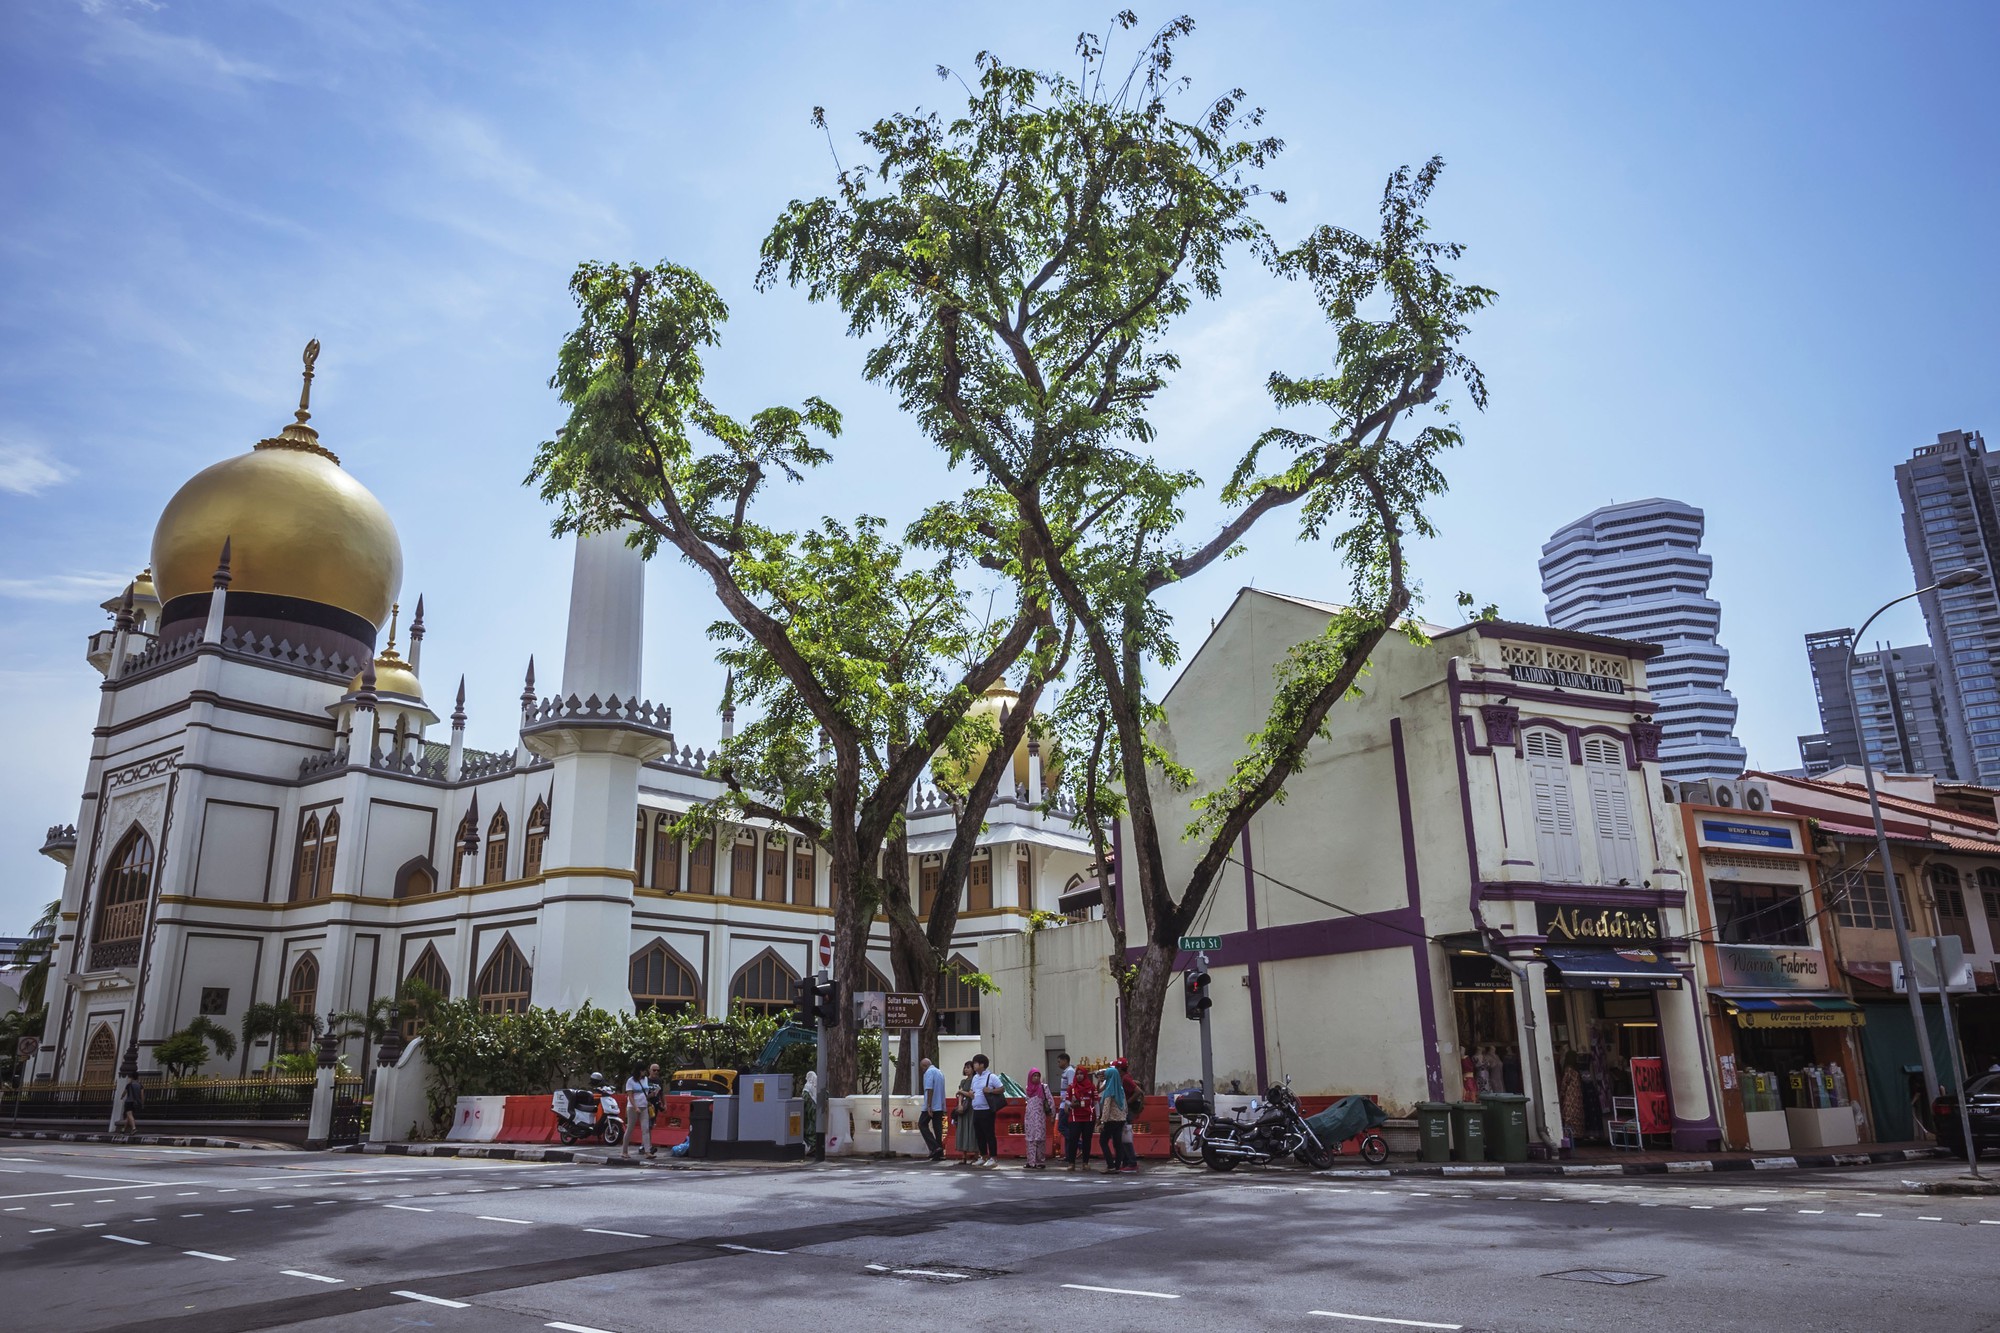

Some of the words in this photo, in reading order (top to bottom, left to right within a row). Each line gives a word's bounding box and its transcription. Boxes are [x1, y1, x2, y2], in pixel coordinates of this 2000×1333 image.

[1514, 667, 1555, 685] ALADDIN'S
[1556, 671, 1589, 690] TRADING
[1591, 676, 1606, 691] PTE
[1607, 678, 1621, 693] LTD
[1546, 905, 1658, 940] Aladdin's
[1184, 938, 1206, 949] Arab
[1208, 938, 1218, 948] St
[1728, 953, 1774, 973] Warna
[1776, 952, 1818, 975] Fabrics
[902, 997, 919, 1006] Mosque
[1770, 1012, 1801, 1021] Warna
[1803, 1012, 1835, 1021] Fabrics
